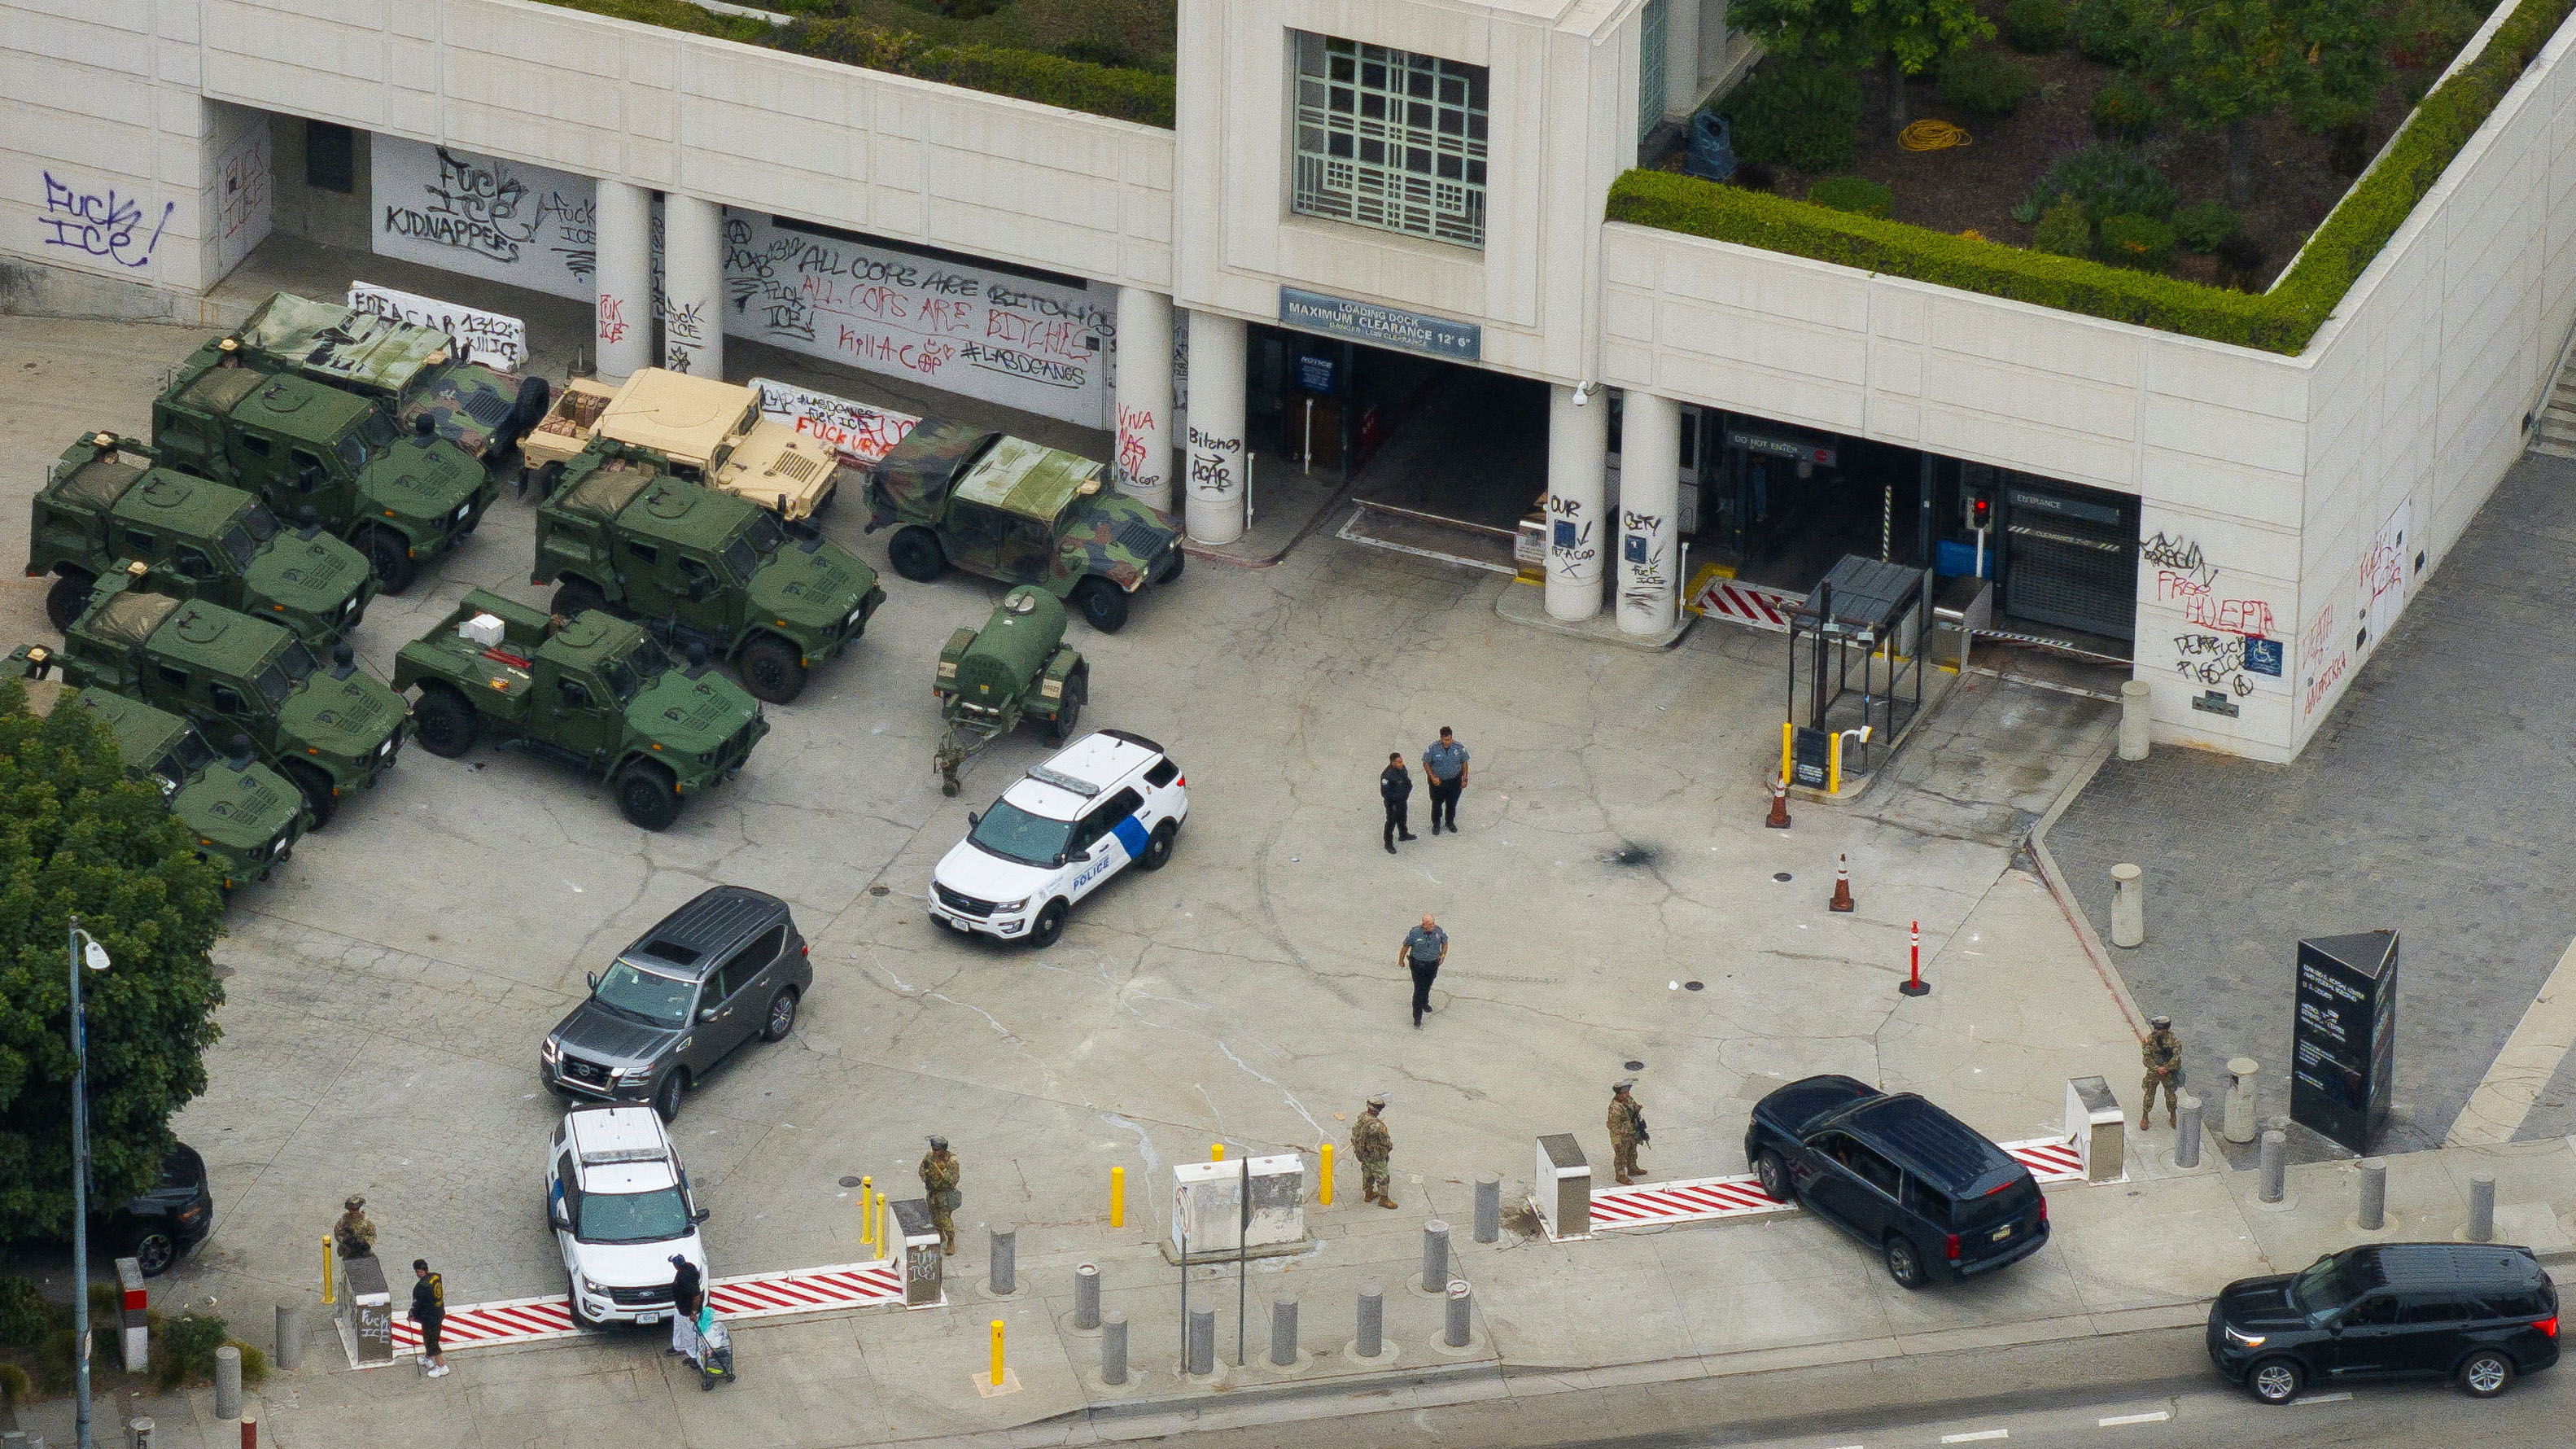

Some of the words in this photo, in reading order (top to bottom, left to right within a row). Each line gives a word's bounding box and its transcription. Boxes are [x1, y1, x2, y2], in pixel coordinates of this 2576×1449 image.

[386, 205, 519, 263] KIDNAPPERS
[798, 246, 847, 276] ALL
[921, 269, 978, 295] ARE
[1288, 302, 1354, 326] MAXIMUM
[1358, 317, 1433, 341] CLEARANCE
[1339, 303, 1387, 321] LOADING
[1389, 313, 1419, 327] DOCK
[1118, 402, 1155, 430] VIVA
[1734, 434, 1747, 444] DO
[1750, 437, 1768, 448] NOT
[1550, 494, 1581, 518] OUR
[2017, 493, 2062, 510] ENTRANCE
[1074, 857, 1110, 891] POLICE
